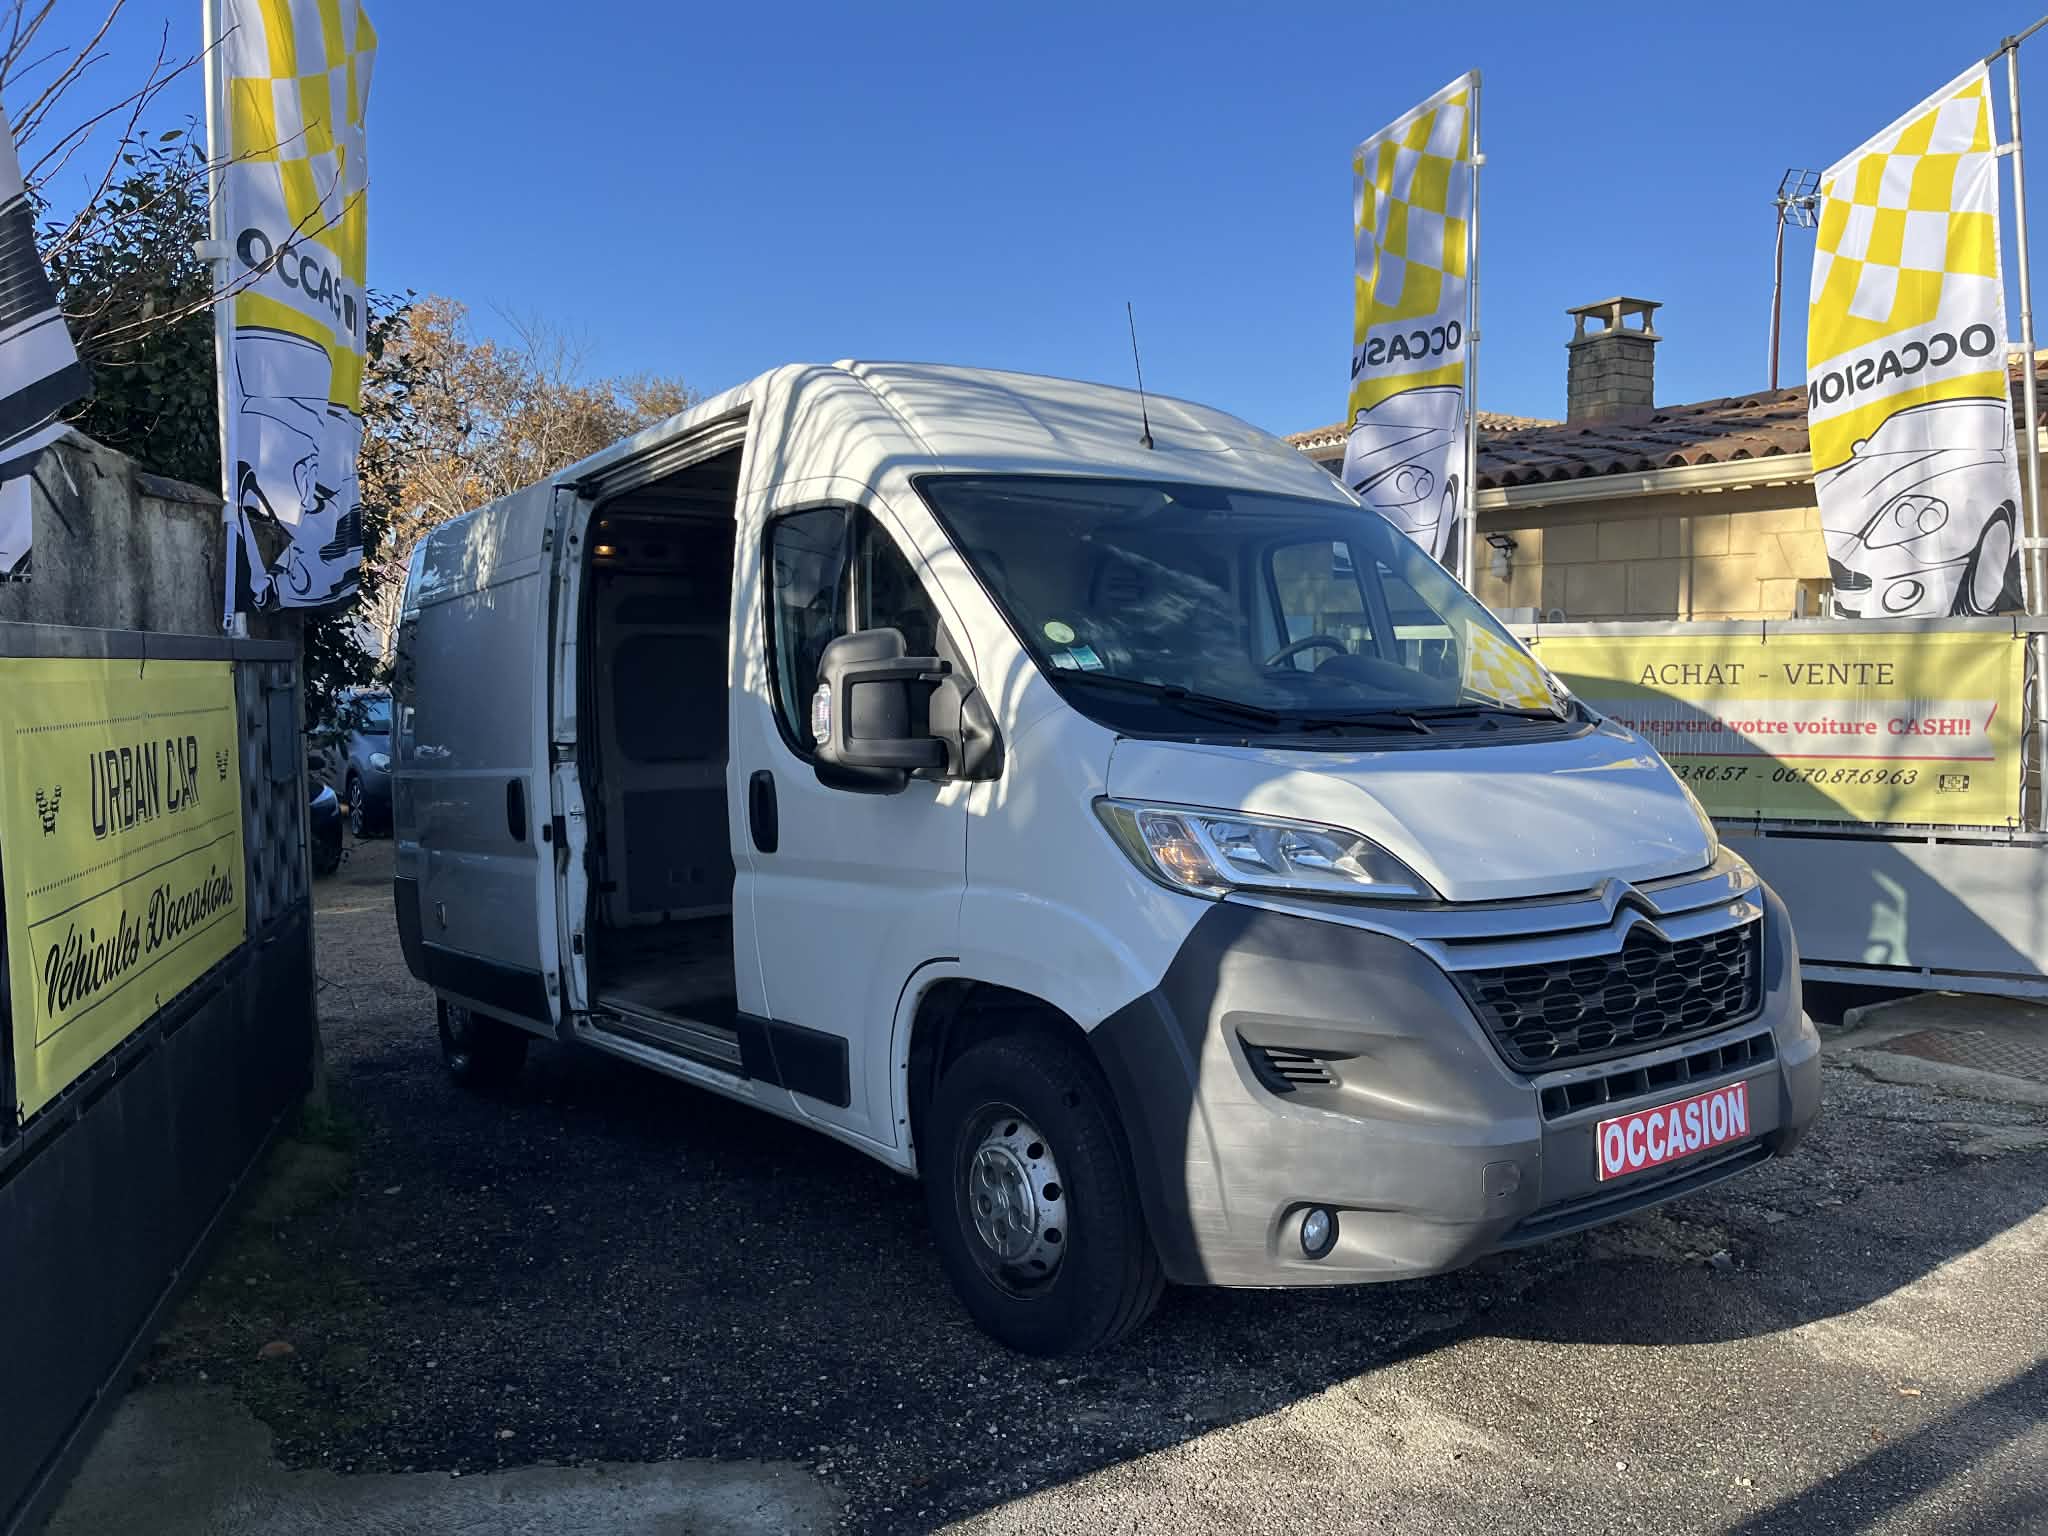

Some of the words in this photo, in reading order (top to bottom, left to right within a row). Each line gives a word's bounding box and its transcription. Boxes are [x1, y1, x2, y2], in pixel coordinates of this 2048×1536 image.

[1639, 663, 1744, 685] ACHAT
[1783, 663, 1895, 685] VENTE
[1640, 716, 1723, 736] reprend
[1728, 718, 1789, 734] votre
[1793, 716, 1878, 735] voiture
[1887, 718, 1971, 736] CASH!!
[90, 741, 160, 840] URBAN
[166, 735, 200, 814] CAR
[1772, 767, 1918, 785] 06.70.87.69.63
[45, 909, 140, 1019] Véhicules
[146, 864, 233, 954] D'occasions
[1603, 1087, 1746, 1174] OCCASION
